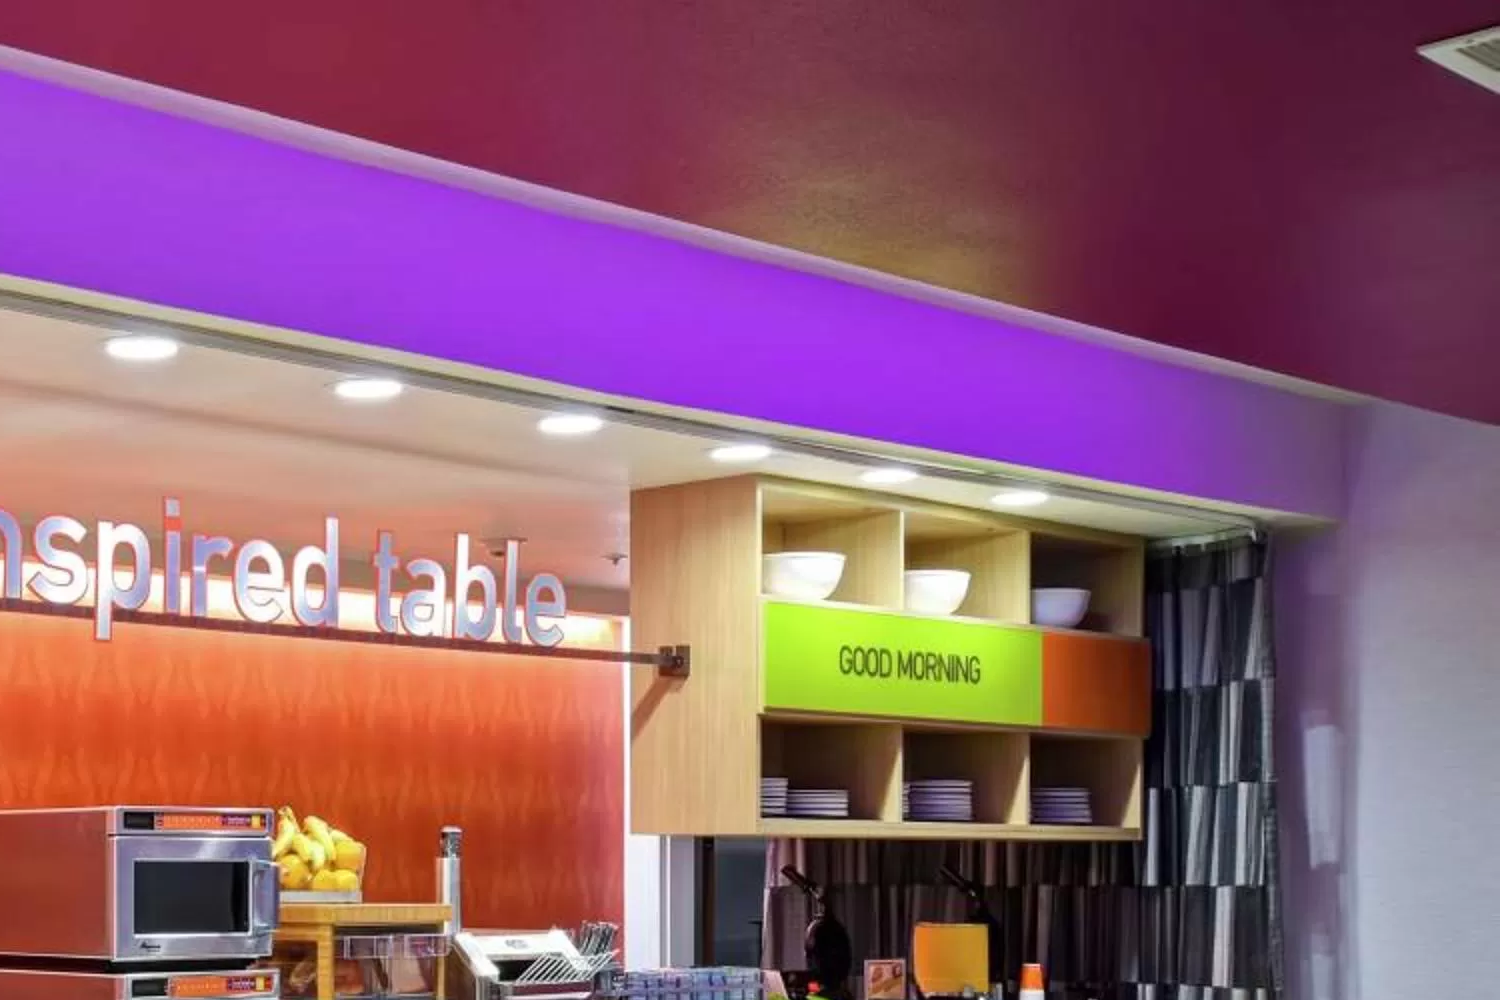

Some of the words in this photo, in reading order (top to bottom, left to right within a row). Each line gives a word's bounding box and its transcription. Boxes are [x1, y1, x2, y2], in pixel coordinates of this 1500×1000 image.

[373, 529, 567, 646] table
[839, 645, 893, 678] GOOD
[897, 650, 981, 684] MORNING
